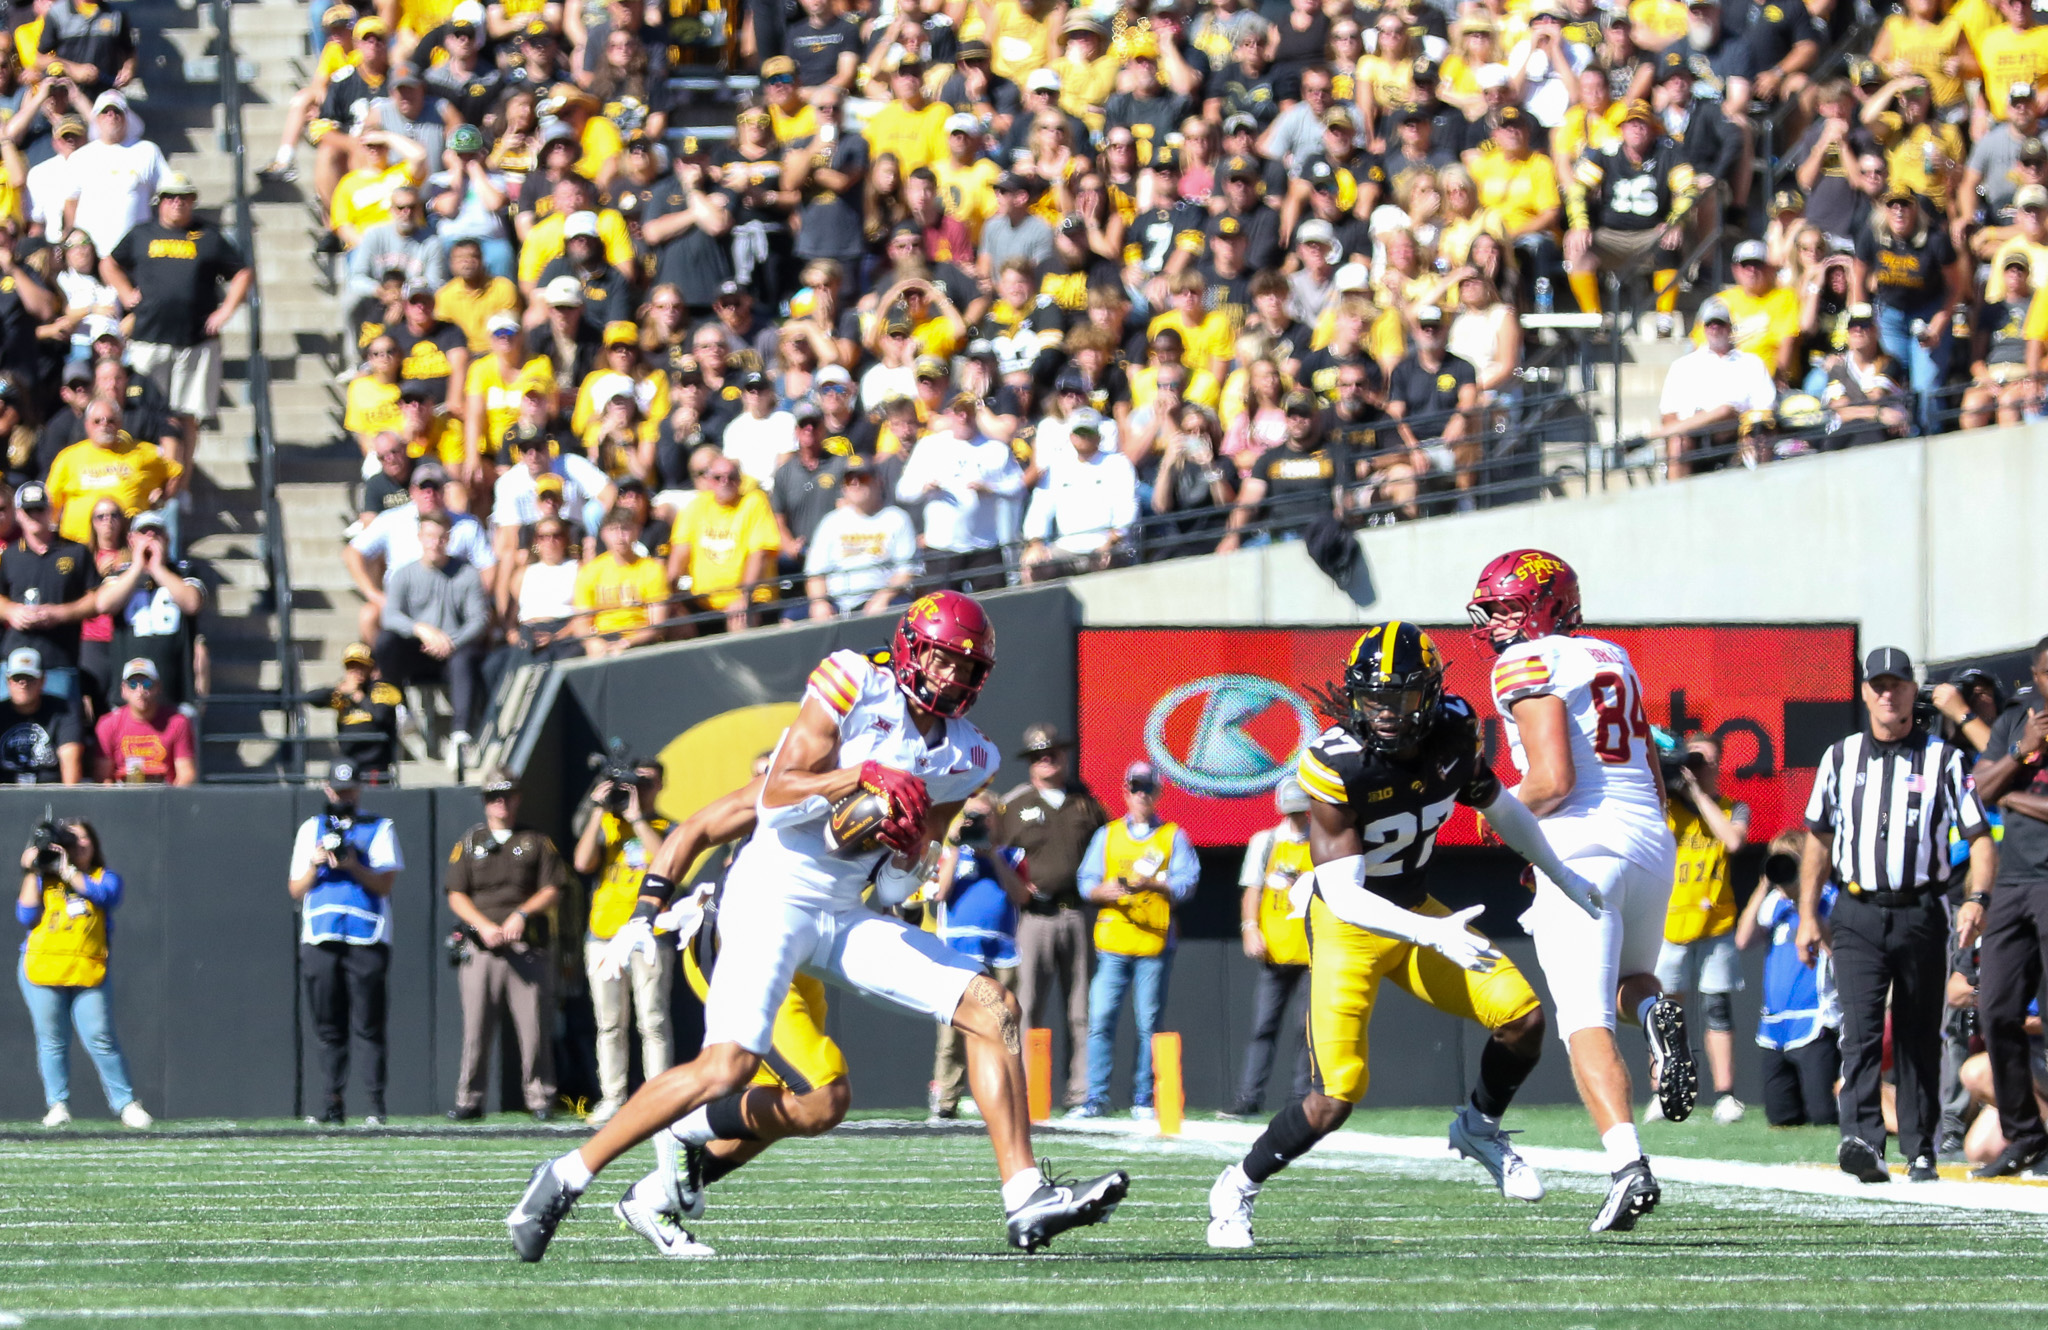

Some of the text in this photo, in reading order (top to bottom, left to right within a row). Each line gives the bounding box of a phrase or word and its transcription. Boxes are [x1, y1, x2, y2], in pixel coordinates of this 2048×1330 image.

[1515, 558, 1565, 582] STATE
[1590, 672, 1649, 764] 84
[1310, 727, 1363, 756] 27
[1908, 808, 1919, 826] F
[1364, 796, 1455, 877] 27
